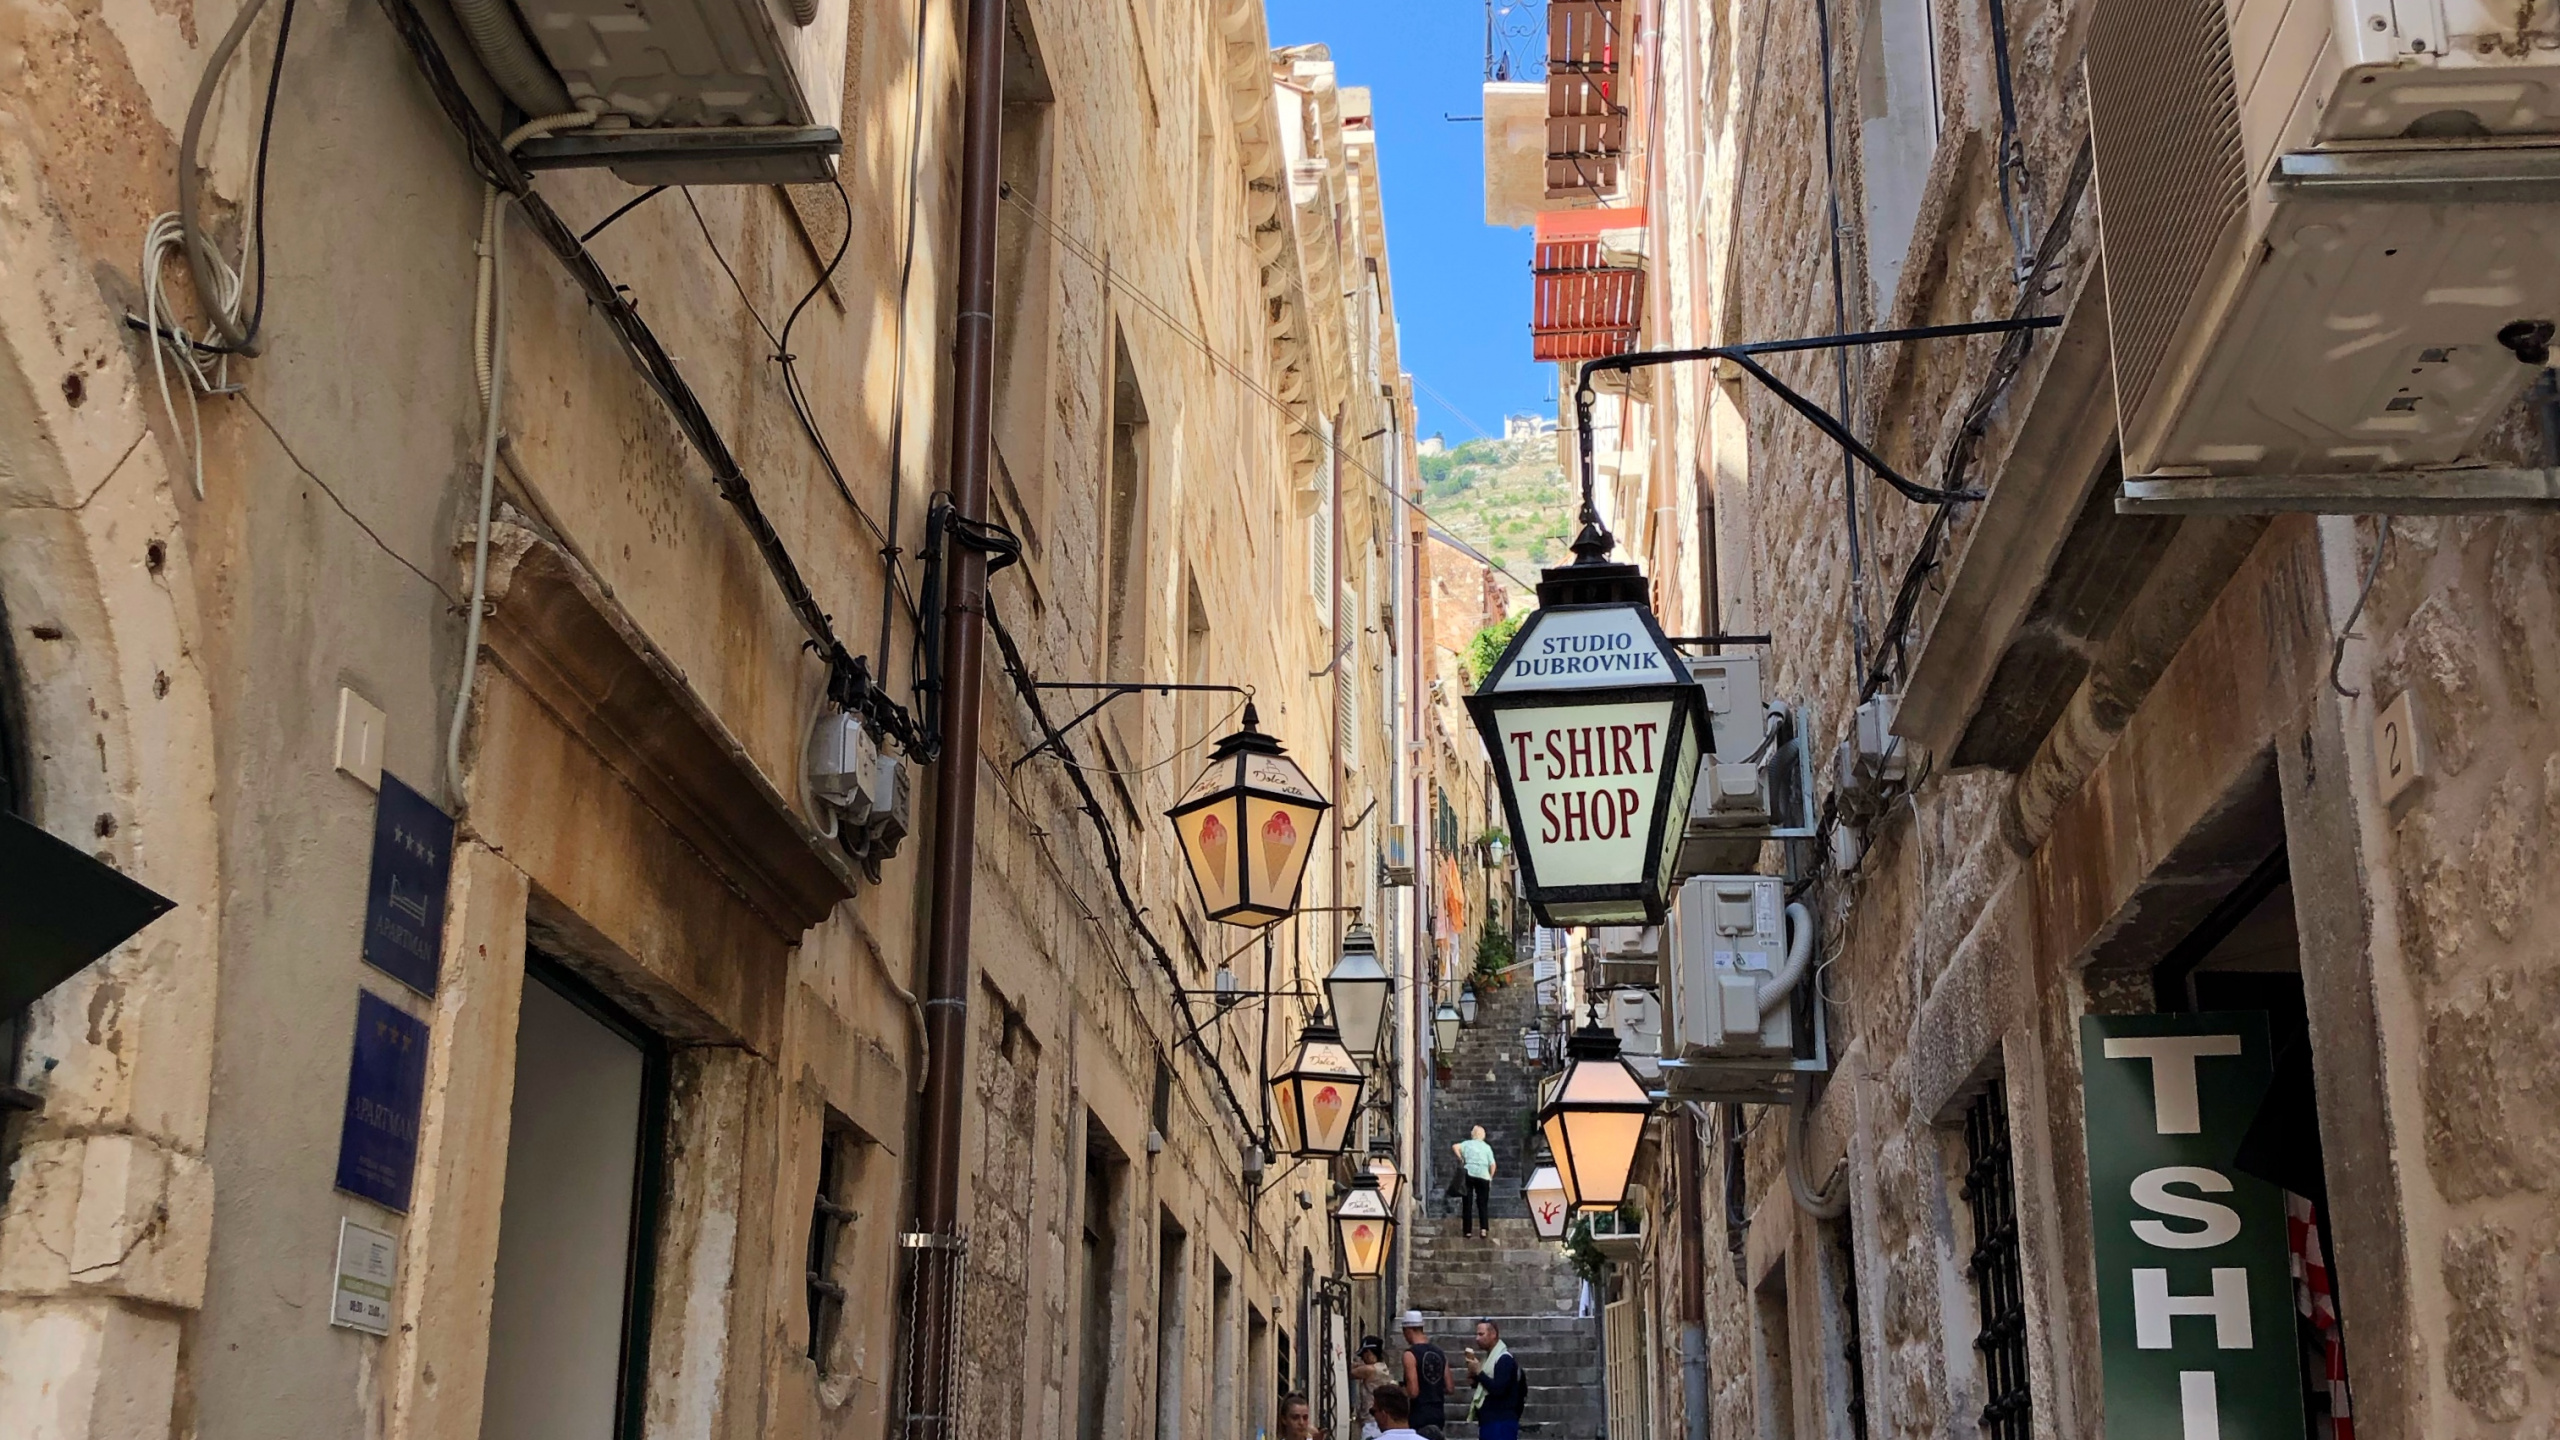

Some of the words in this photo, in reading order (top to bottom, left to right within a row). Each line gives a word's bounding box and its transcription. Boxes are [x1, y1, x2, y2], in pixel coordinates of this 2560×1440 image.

[1515, 651, 1660, 678] DUBROVNIK
[1542, 633, 1632, 655] STUDIO
[1510, 722, 1658, 782] T-SHIRT
[2384, 721, 2402, 779] 2
[1253, 768, 1287, 785] Dolce
[1540, 788, 1640, 844] SHOP
[374, 914, 433, 963] APARTMAN
[350, 1095, 415, 1143] APARTMAN
